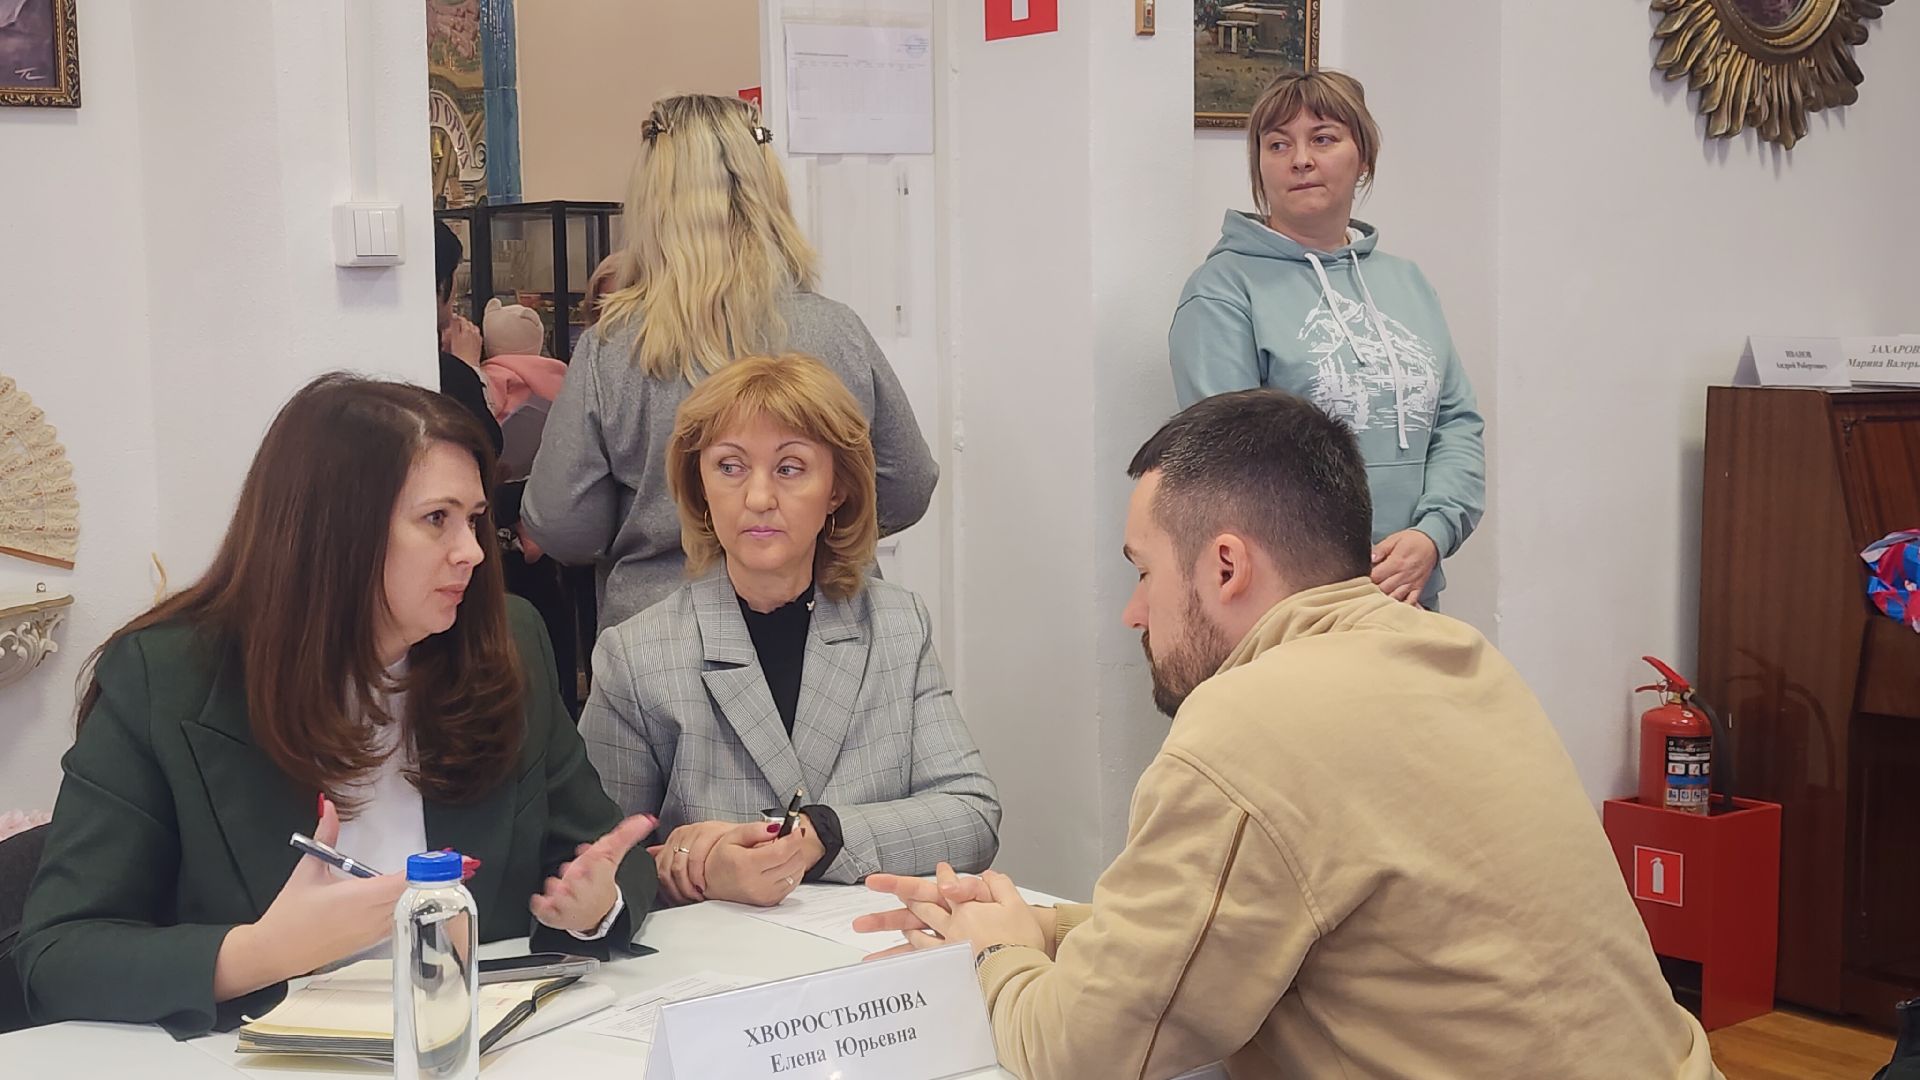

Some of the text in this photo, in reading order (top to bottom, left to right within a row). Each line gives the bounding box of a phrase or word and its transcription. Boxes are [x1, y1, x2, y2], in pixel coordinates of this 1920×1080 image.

[1848, 358, 1883, 369] Марина
[744, 990, 928, 1048] ХВОРОСТЬЯНОВА
[770, 1026, 917, 1073] Елена Юрьевна
